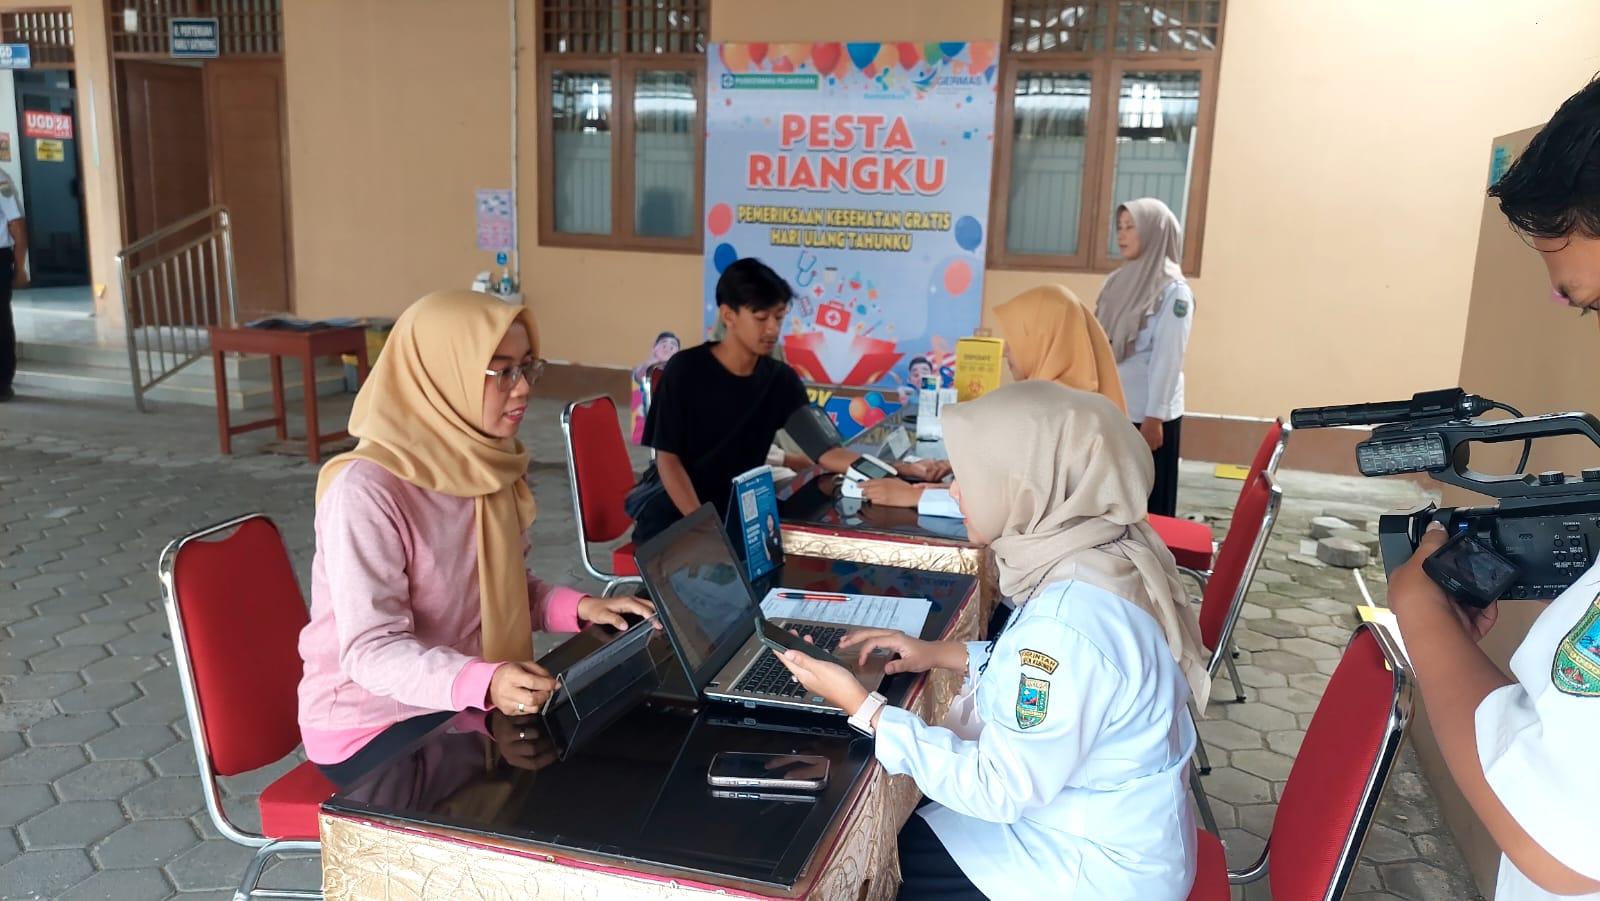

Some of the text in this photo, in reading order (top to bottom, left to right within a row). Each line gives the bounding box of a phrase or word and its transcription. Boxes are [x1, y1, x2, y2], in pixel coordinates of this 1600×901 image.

[26, 113, 70, 131] UGD 24
[781, 114, 914, 150] PESTA
[748, 154, 946, 192] RIANGKU
[738, 206, 951, 231] PEMERIKSAAN KESEHATAN GRATIS
[771, 228, 912, 251] HARI ULANG TAHUNKU
